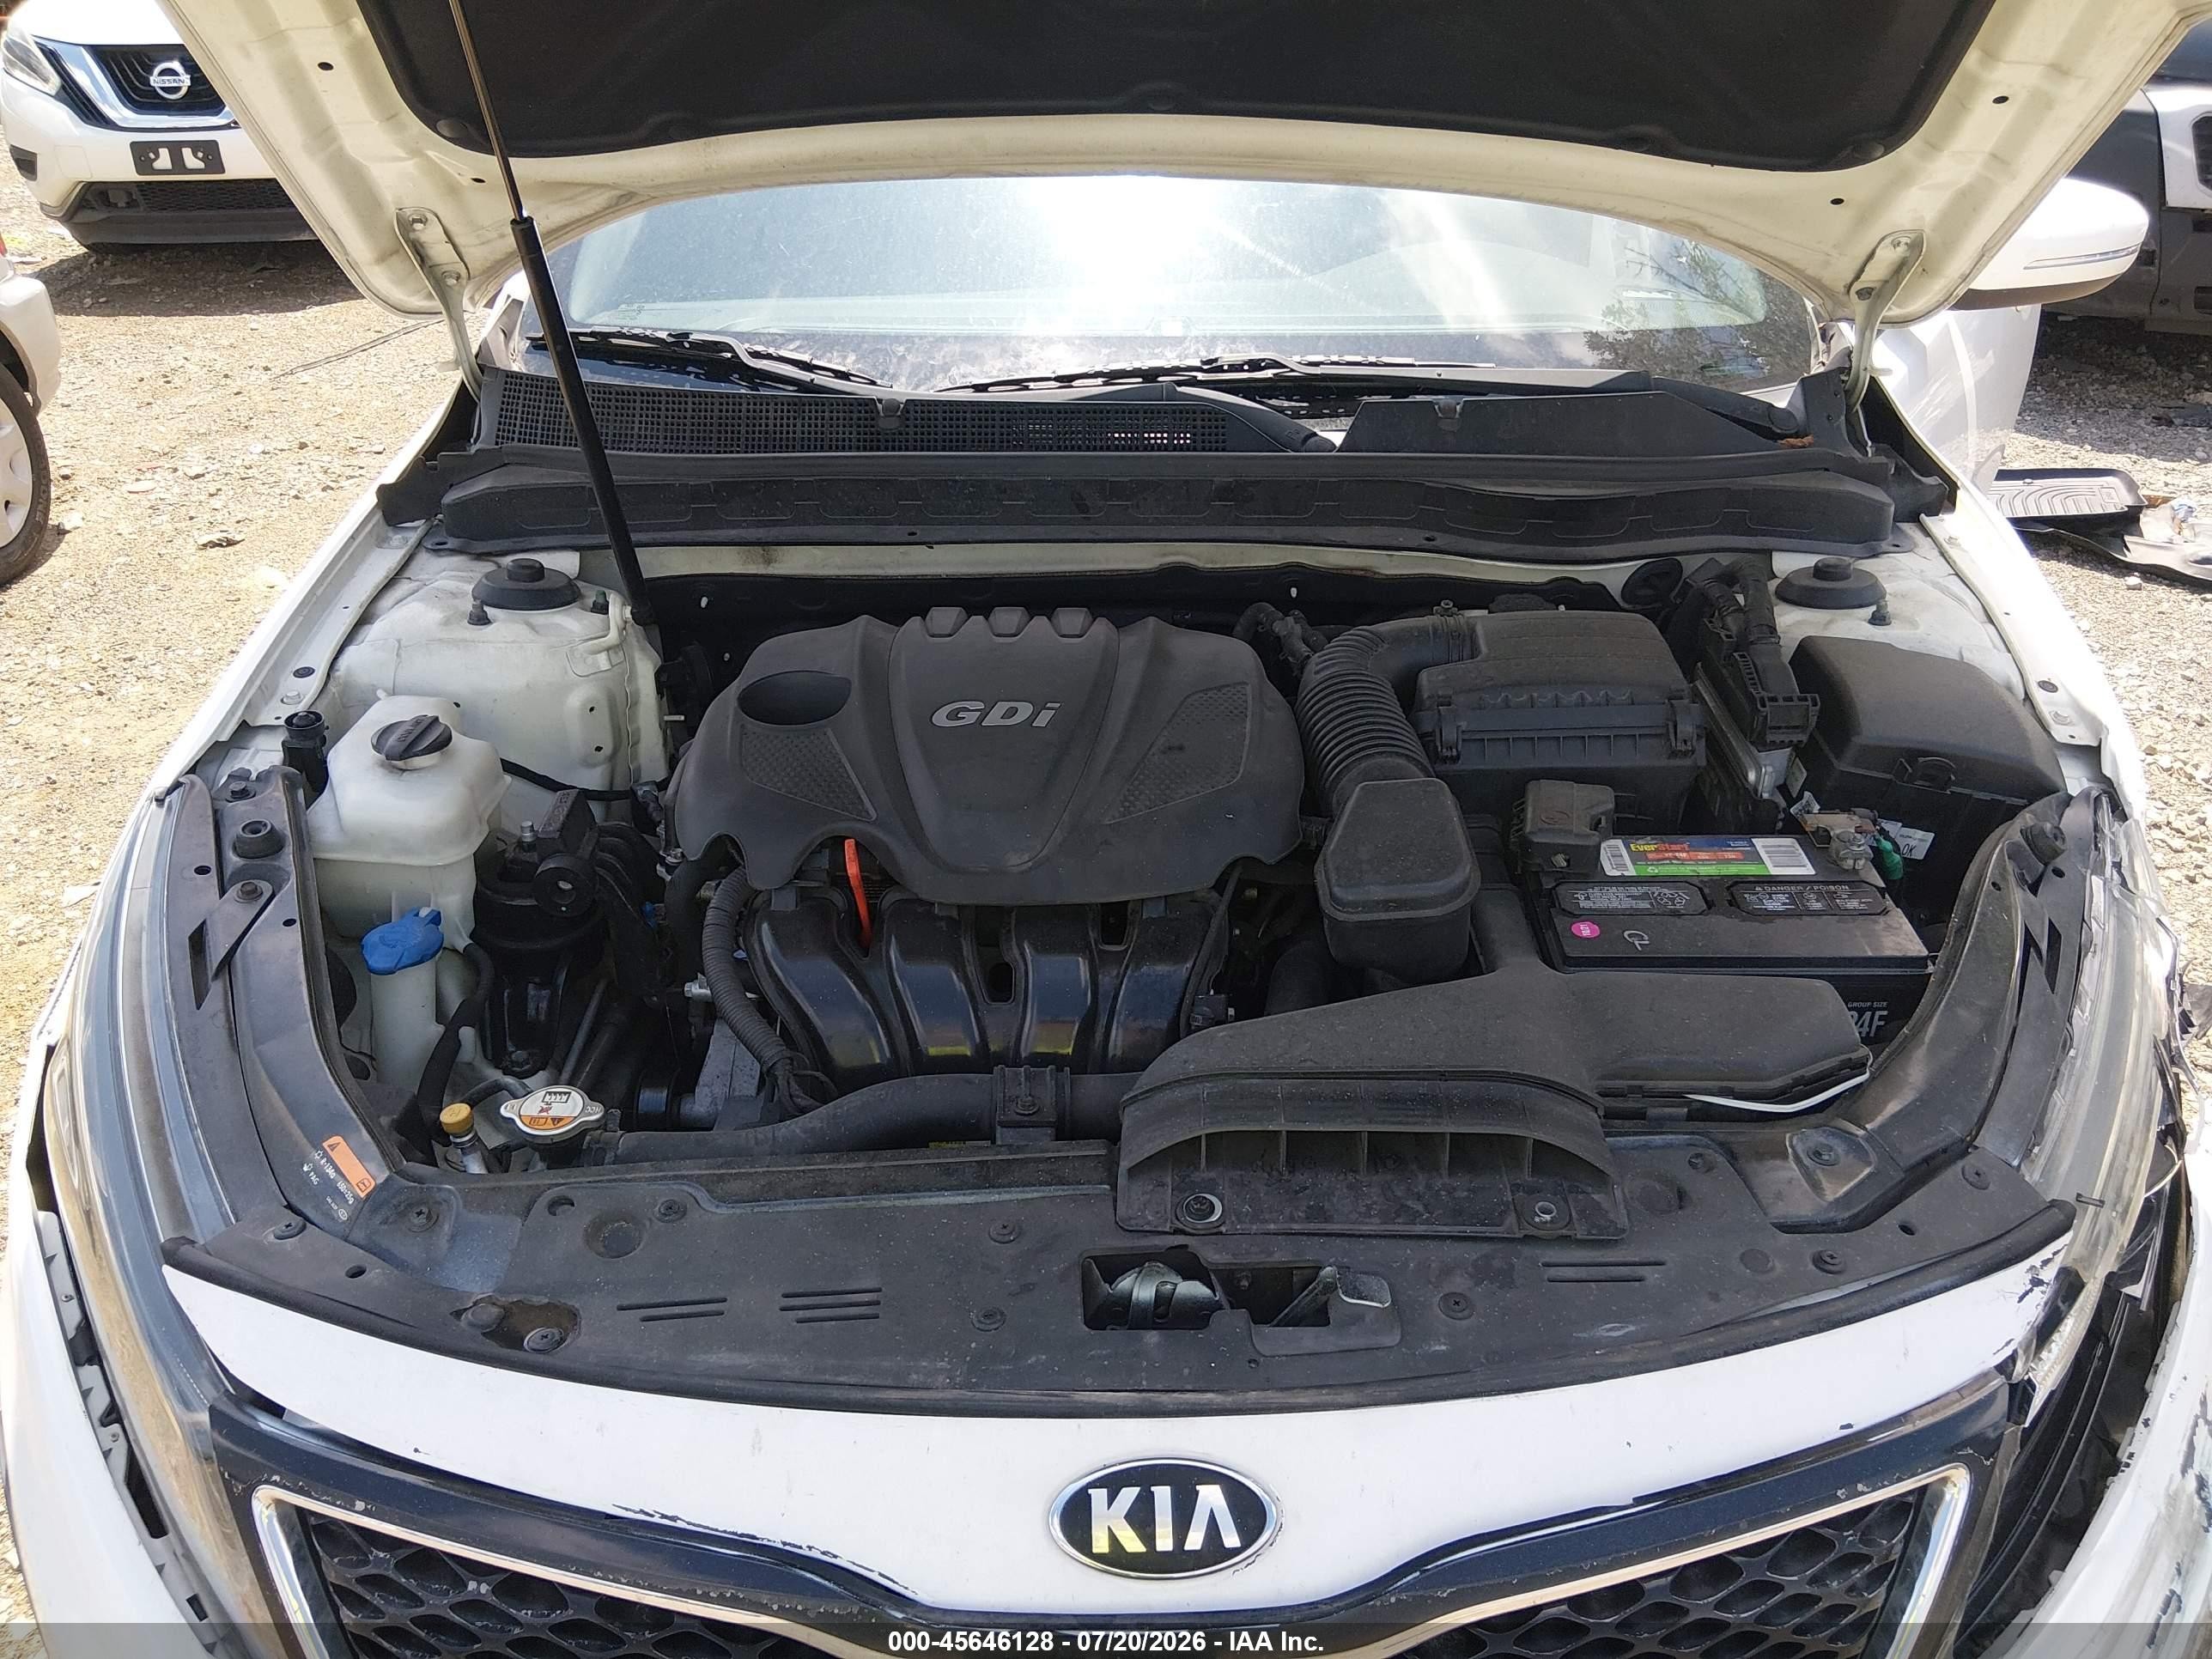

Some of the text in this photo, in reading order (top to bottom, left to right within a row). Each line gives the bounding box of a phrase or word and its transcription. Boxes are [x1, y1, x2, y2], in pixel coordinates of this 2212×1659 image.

[932, 701, 1061, 727] GDi
[1629, 842, 1691, 852] EverStart
[1902, 843, 1917, 857] OK
[1088, 1485, 1242, 1553] KIA
